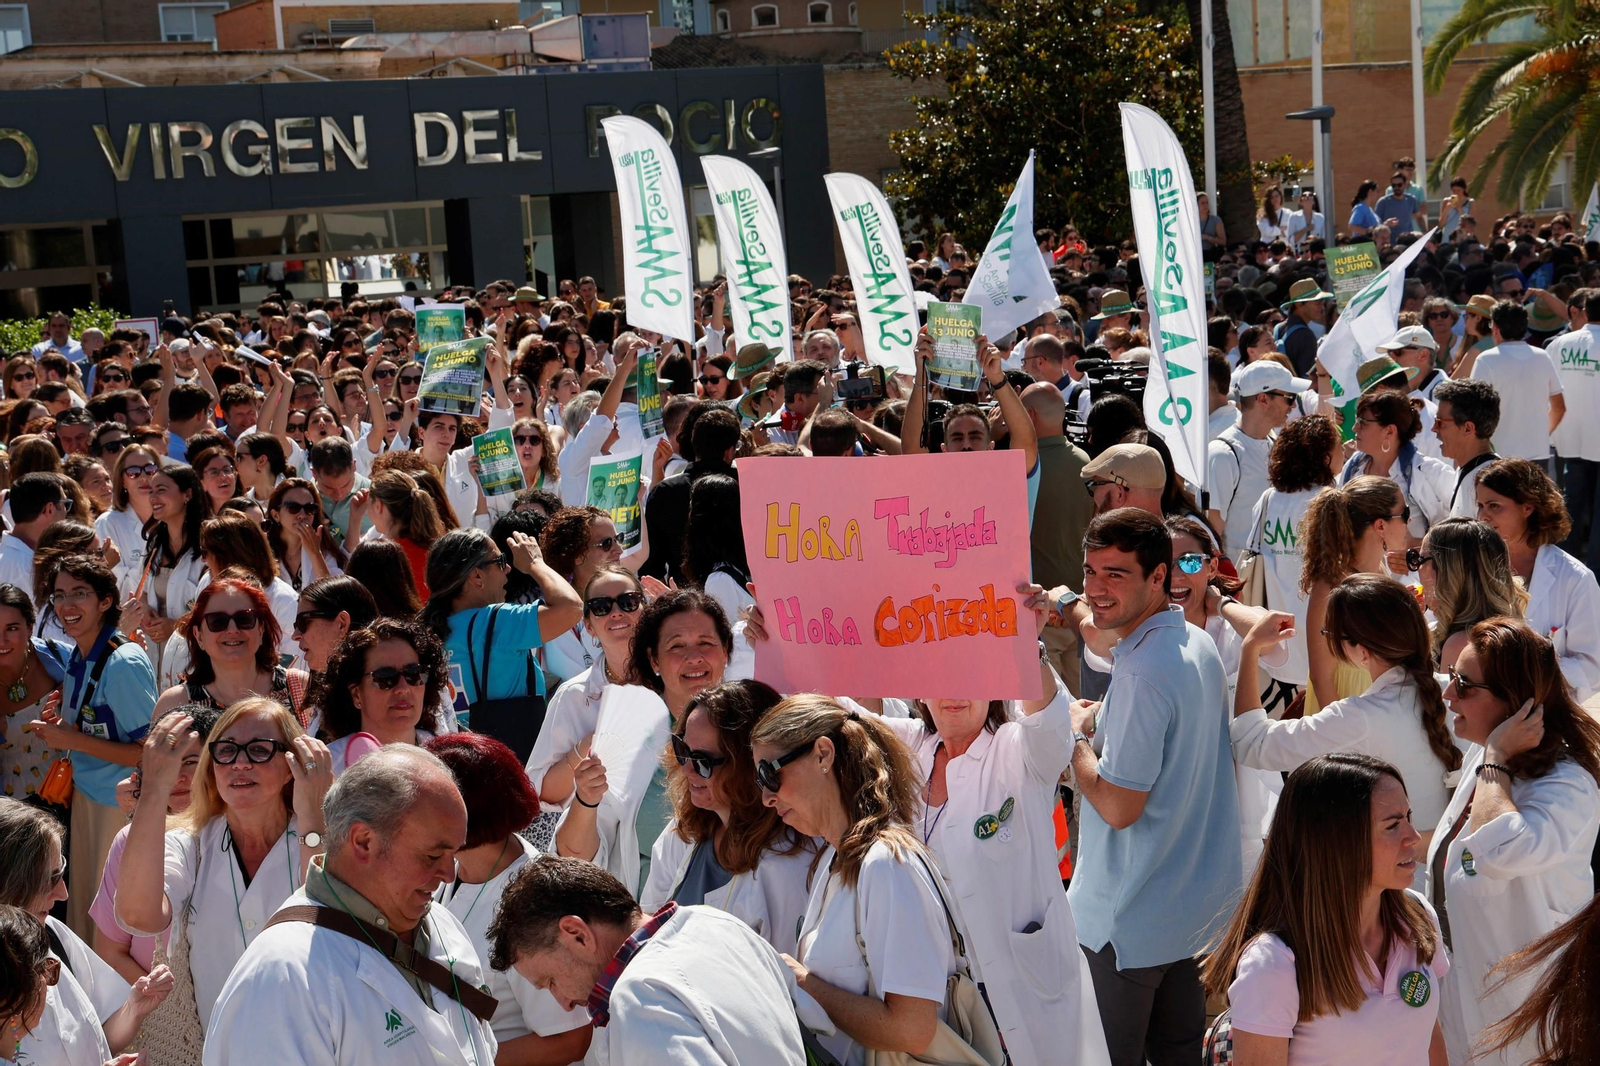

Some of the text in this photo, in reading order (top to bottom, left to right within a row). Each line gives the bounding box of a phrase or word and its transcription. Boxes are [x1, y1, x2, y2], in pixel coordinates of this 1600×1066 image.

[92, 115, 369, 182] VIRGEN
[413, 108, 543, 167] DEL
[1334, 253, 1370, 266] HUELGA
[1334, 261, 1373, 275] 13 JUNIO
[979, 274, 1005, 307] Sevilla
[934, 317, 974, 328] HUELGA
[932, 327, 975, 337] 13 JUNIO
[435, 349, 476, 362] HUELGA
[445, 356, 477, 366] JUNIO
[478, 440, 507, 452] HUELGA
[487, 446, 509, 457] JUNIO
[609, 468, 636, 480] HUELGA
[607, 475, 637, 488] 13 JUNIO
[873, 496, 998, 568] Trabajada
[1263, 516, 1298, 550] SM
[1405, 972, 1419, 1002] HUELGA
